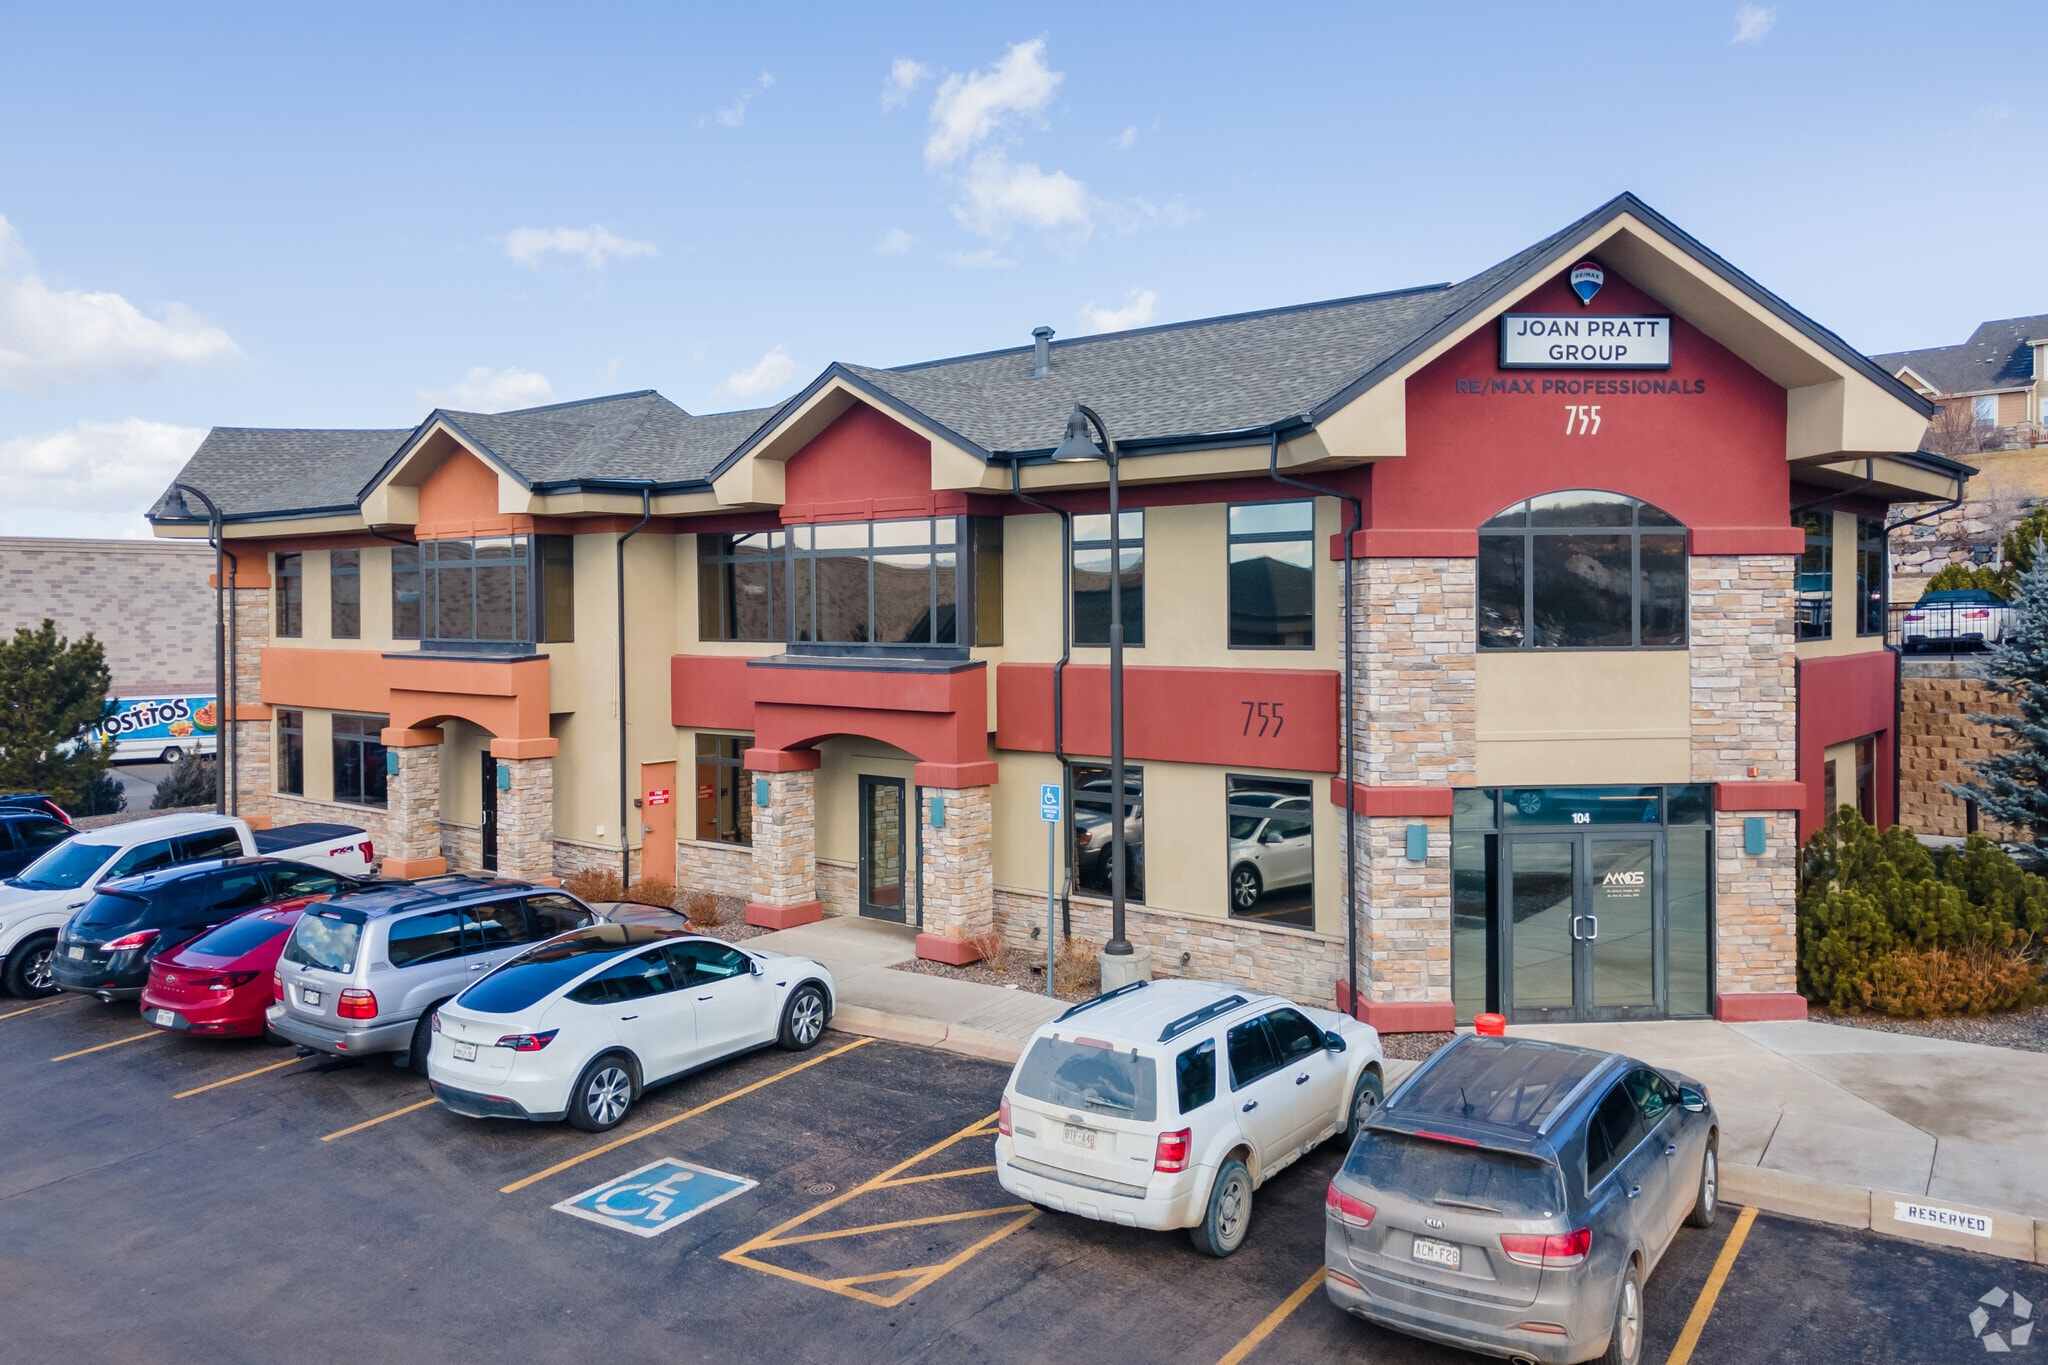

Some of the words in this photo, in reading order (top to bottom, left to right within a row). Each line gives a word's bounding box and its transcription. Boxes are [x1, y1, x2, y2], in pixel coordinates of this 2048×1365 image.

[1575, 272, 1600, 280] RE/MAX
[1517, 320, 1579, 337] JOAN
[1587, 320, 1660, 338] PRATT
[1548, 344, 1628, 361] GROUP
[1456, 377, 1535, 396] RE/MAX
[1542, 379, 1706, 395] PROFESSIONALS
[1565, 405, 1601, 435] 755
[1241, 701, 1284, 738] 755
[1571, 812, 1591, 824] 104
[1602, 871, 1645, 885] AMOS
[1426, 1218, 1443, 1229] KIA
[1909, 1206, 1985, 1231] RESERVED
